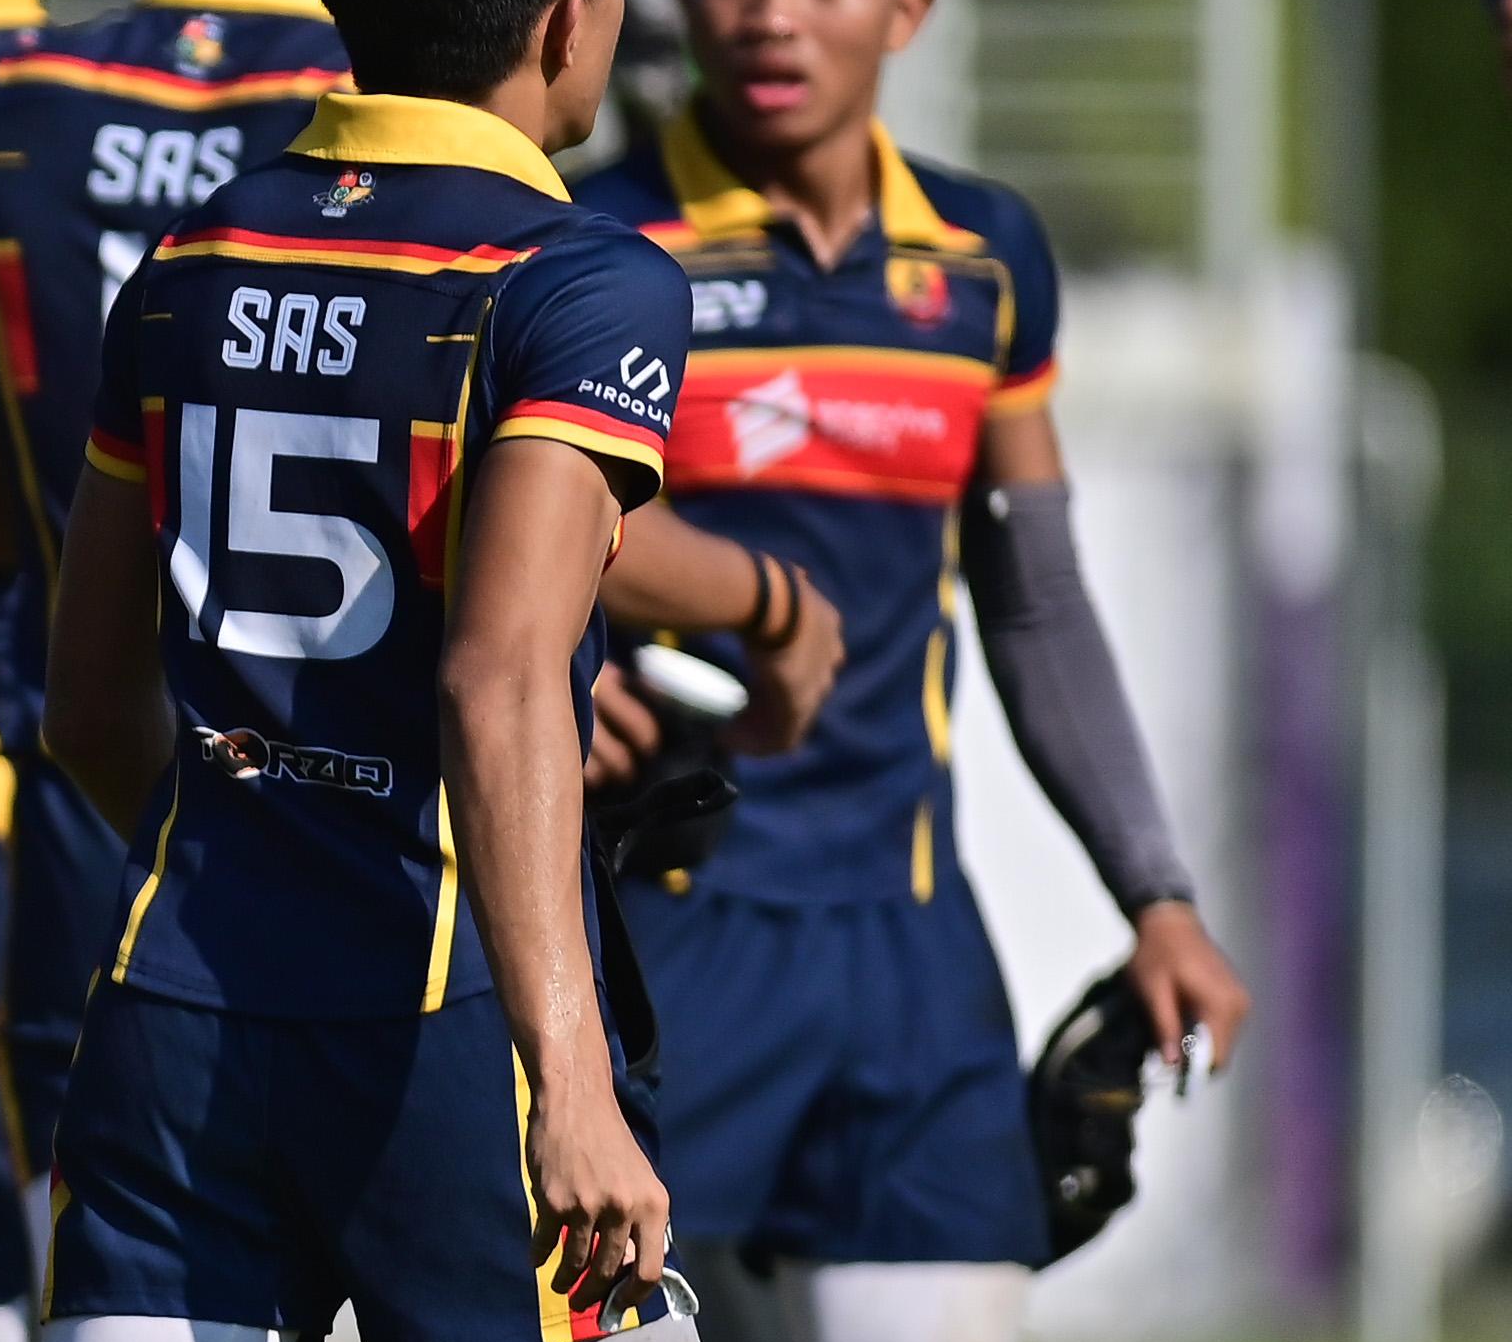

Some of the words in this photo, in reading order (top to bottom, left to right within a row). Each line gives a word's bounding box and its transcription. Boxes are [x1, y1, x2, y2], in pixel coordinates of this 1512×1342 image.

[86, 121, 244, 206] SAS
[222, 285, 366, 377] SAS
[169, 403, 396, 659] 15
